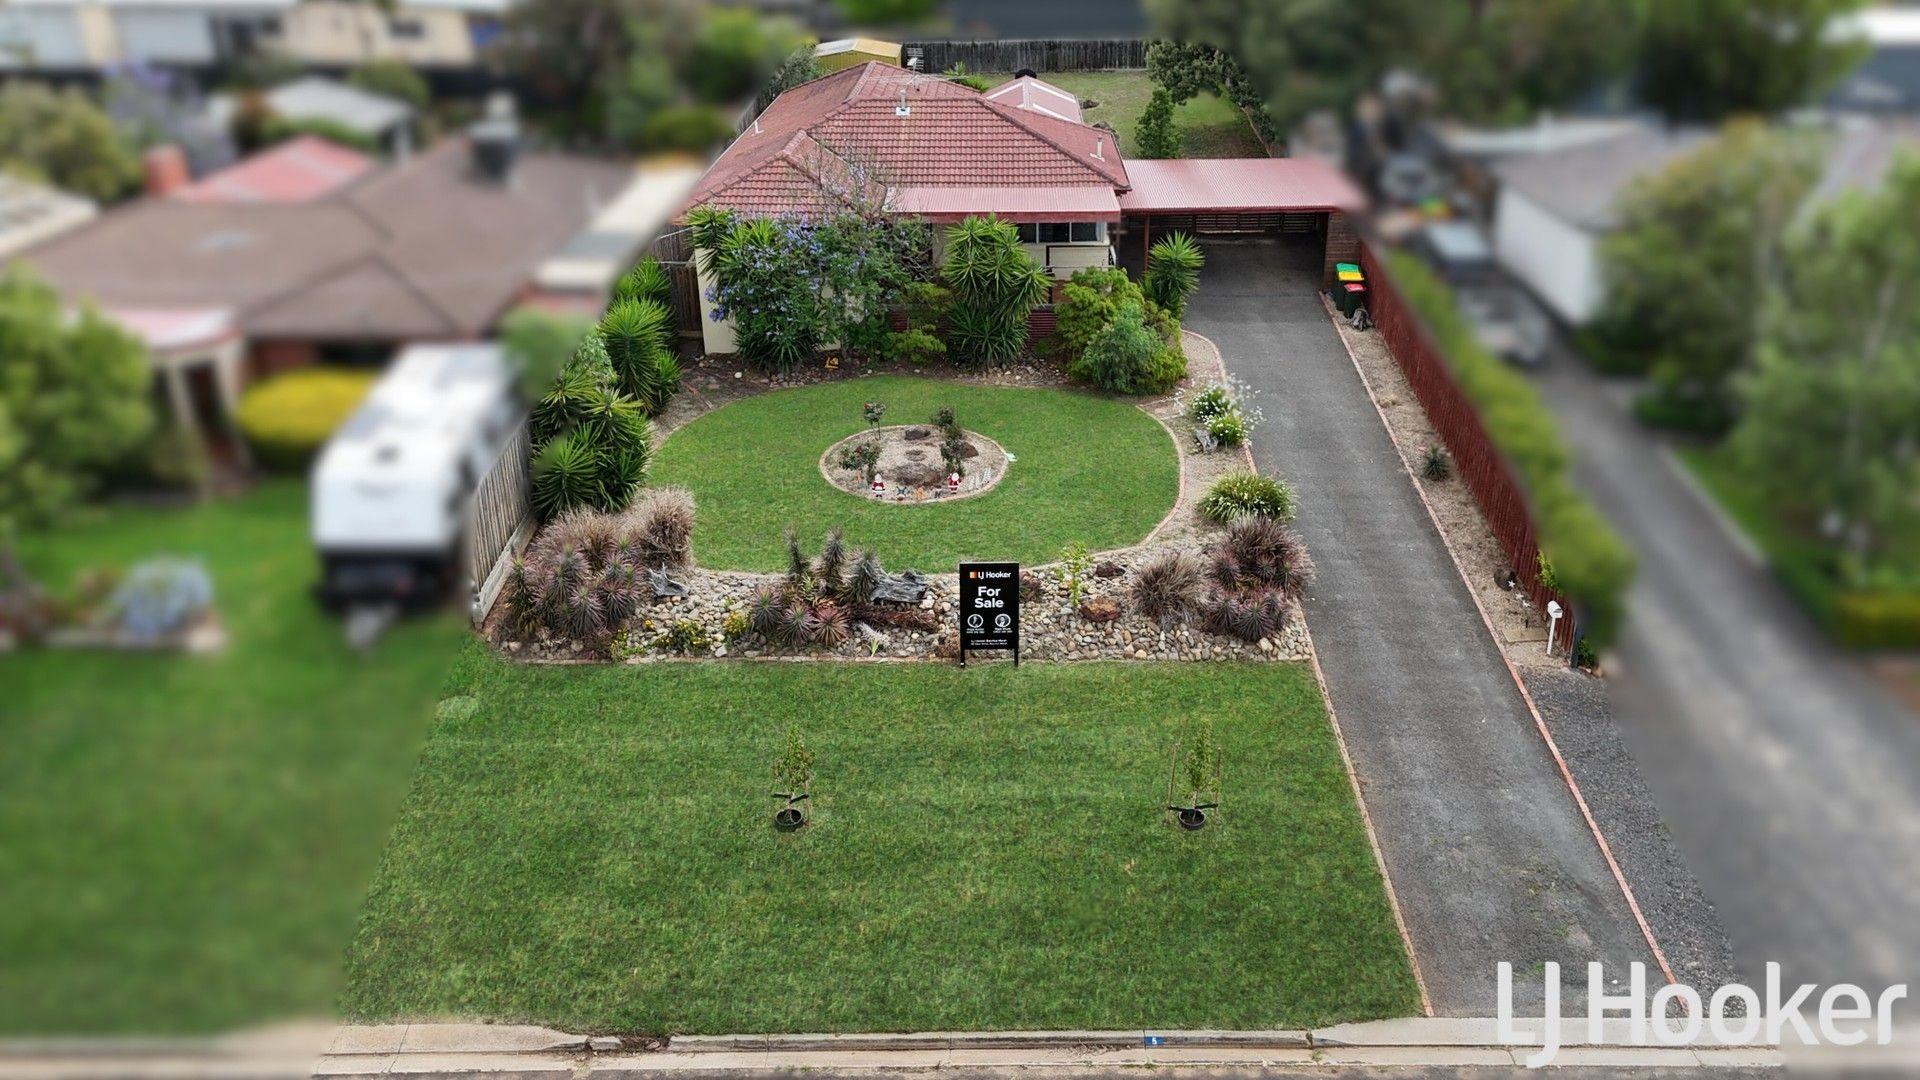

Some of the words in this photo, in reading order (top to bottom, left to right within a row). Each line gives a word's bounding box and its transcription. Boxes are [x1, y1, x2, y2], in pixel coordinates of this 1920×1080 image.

[977, 571, 984, 579] LJ
[978, 586, 1001, 597] For
[974, 597, 1004, 608] Sale
